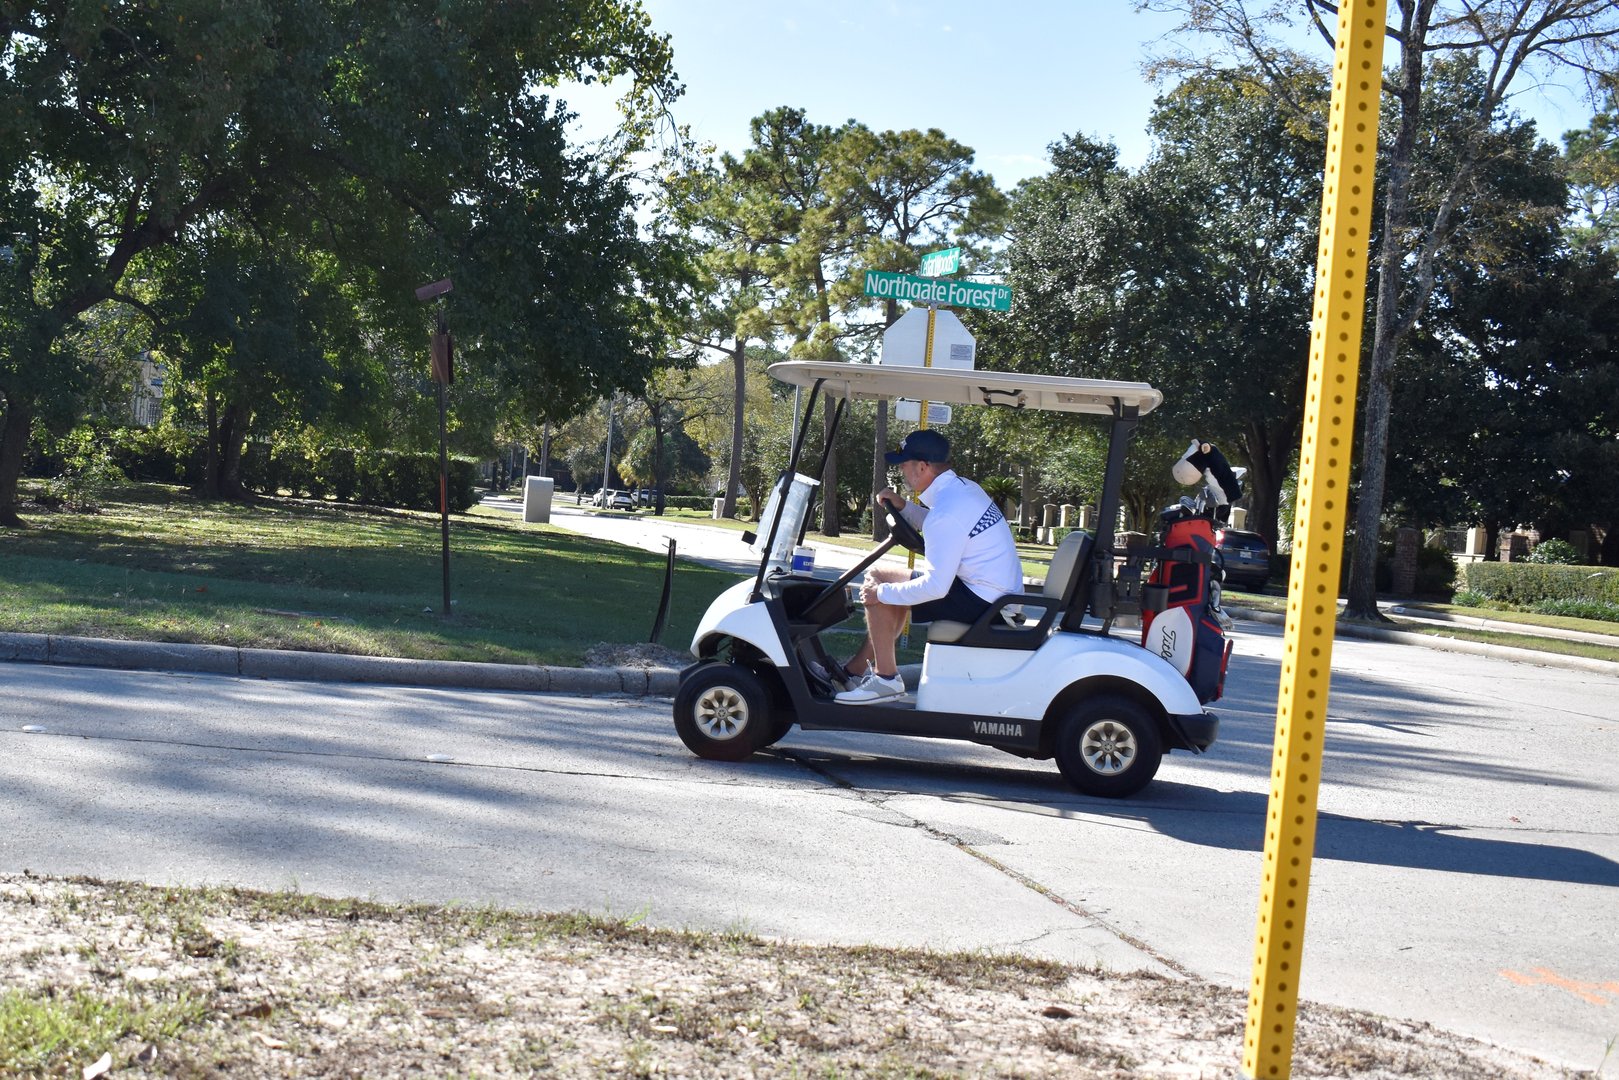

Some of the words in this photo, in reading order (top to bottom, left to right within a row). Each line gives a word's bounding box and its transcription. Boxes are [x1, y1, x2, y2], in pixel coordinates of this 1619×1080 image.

[866, 273, 946, 302] Northgate
[948, 283, 997, 308] Forest
[998, 288, 1009, 300] Dr
[973, 721, 1022, 737] YAMAHA
